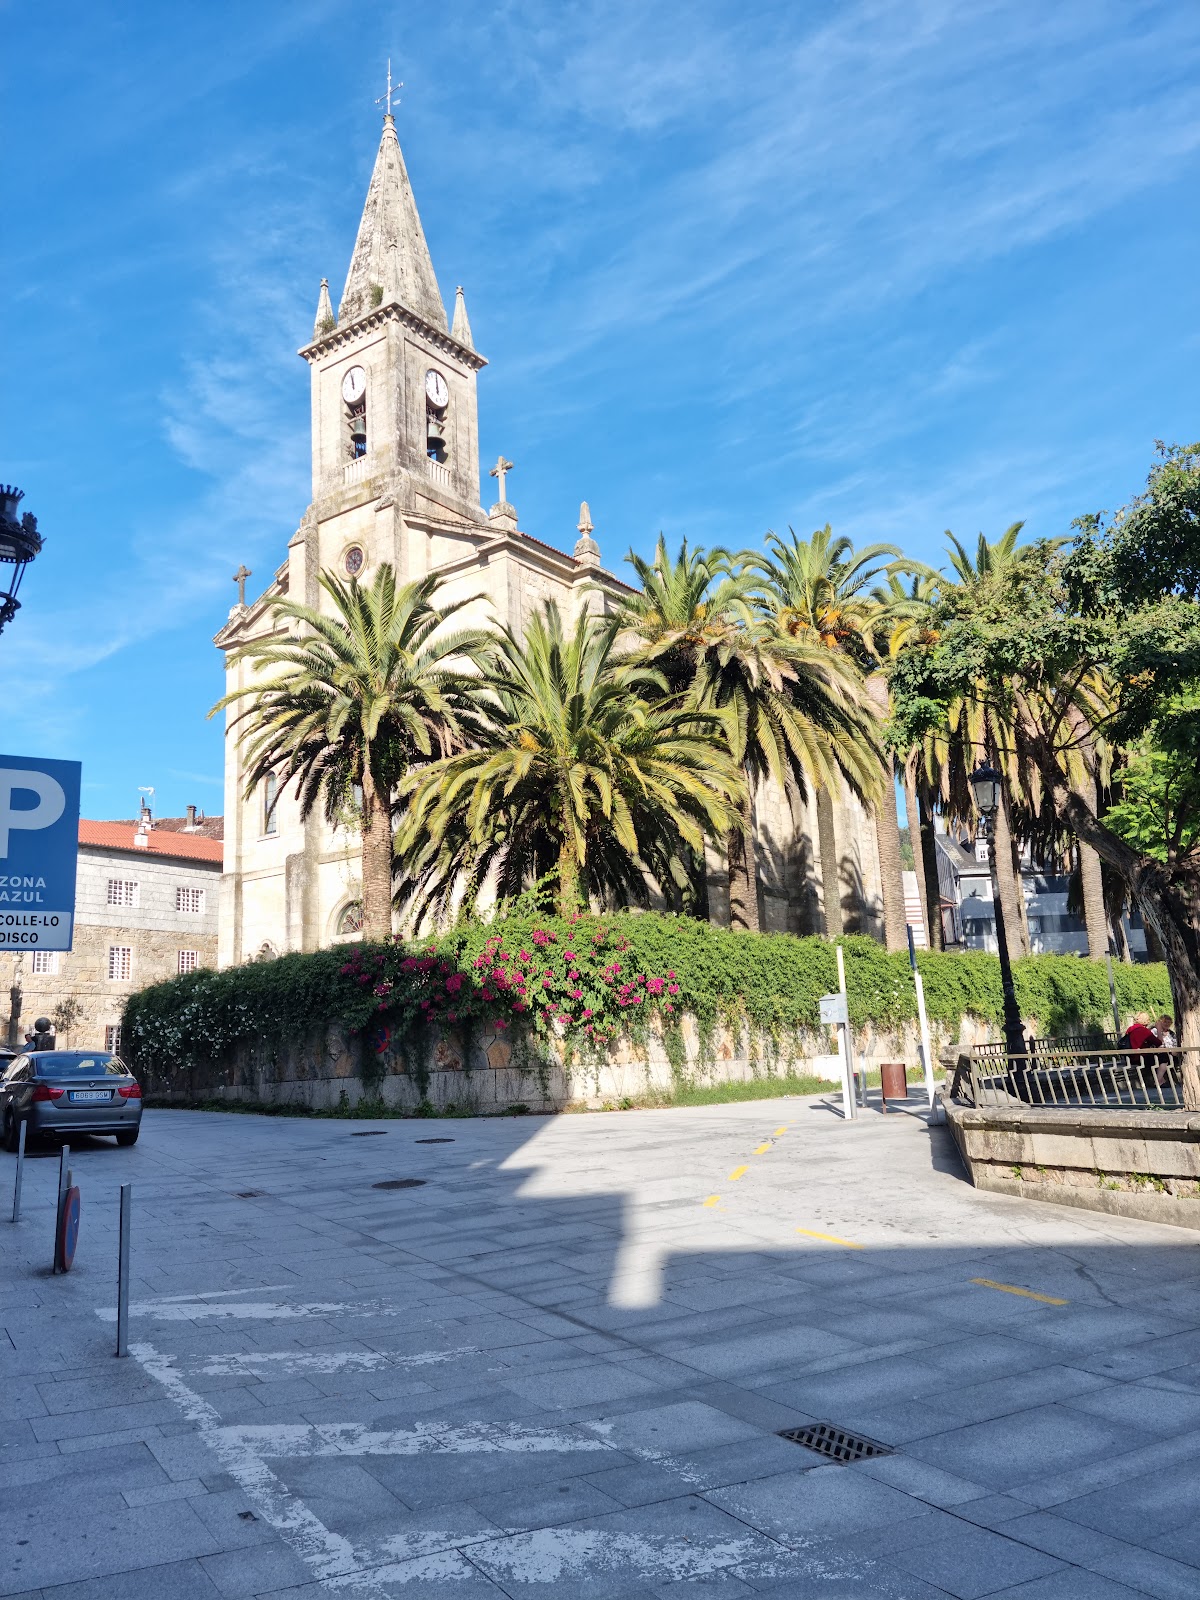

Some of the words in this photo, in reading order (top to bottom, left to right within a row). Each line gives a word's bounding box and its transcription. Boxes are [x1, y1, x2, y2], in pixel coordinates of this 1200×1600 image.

[0, 768, 66, 859] P
[0, 876, 46, 888] ZONA
[0, 890, 44, 903] AZUL
[0, 932, 39, 944] DISCO
